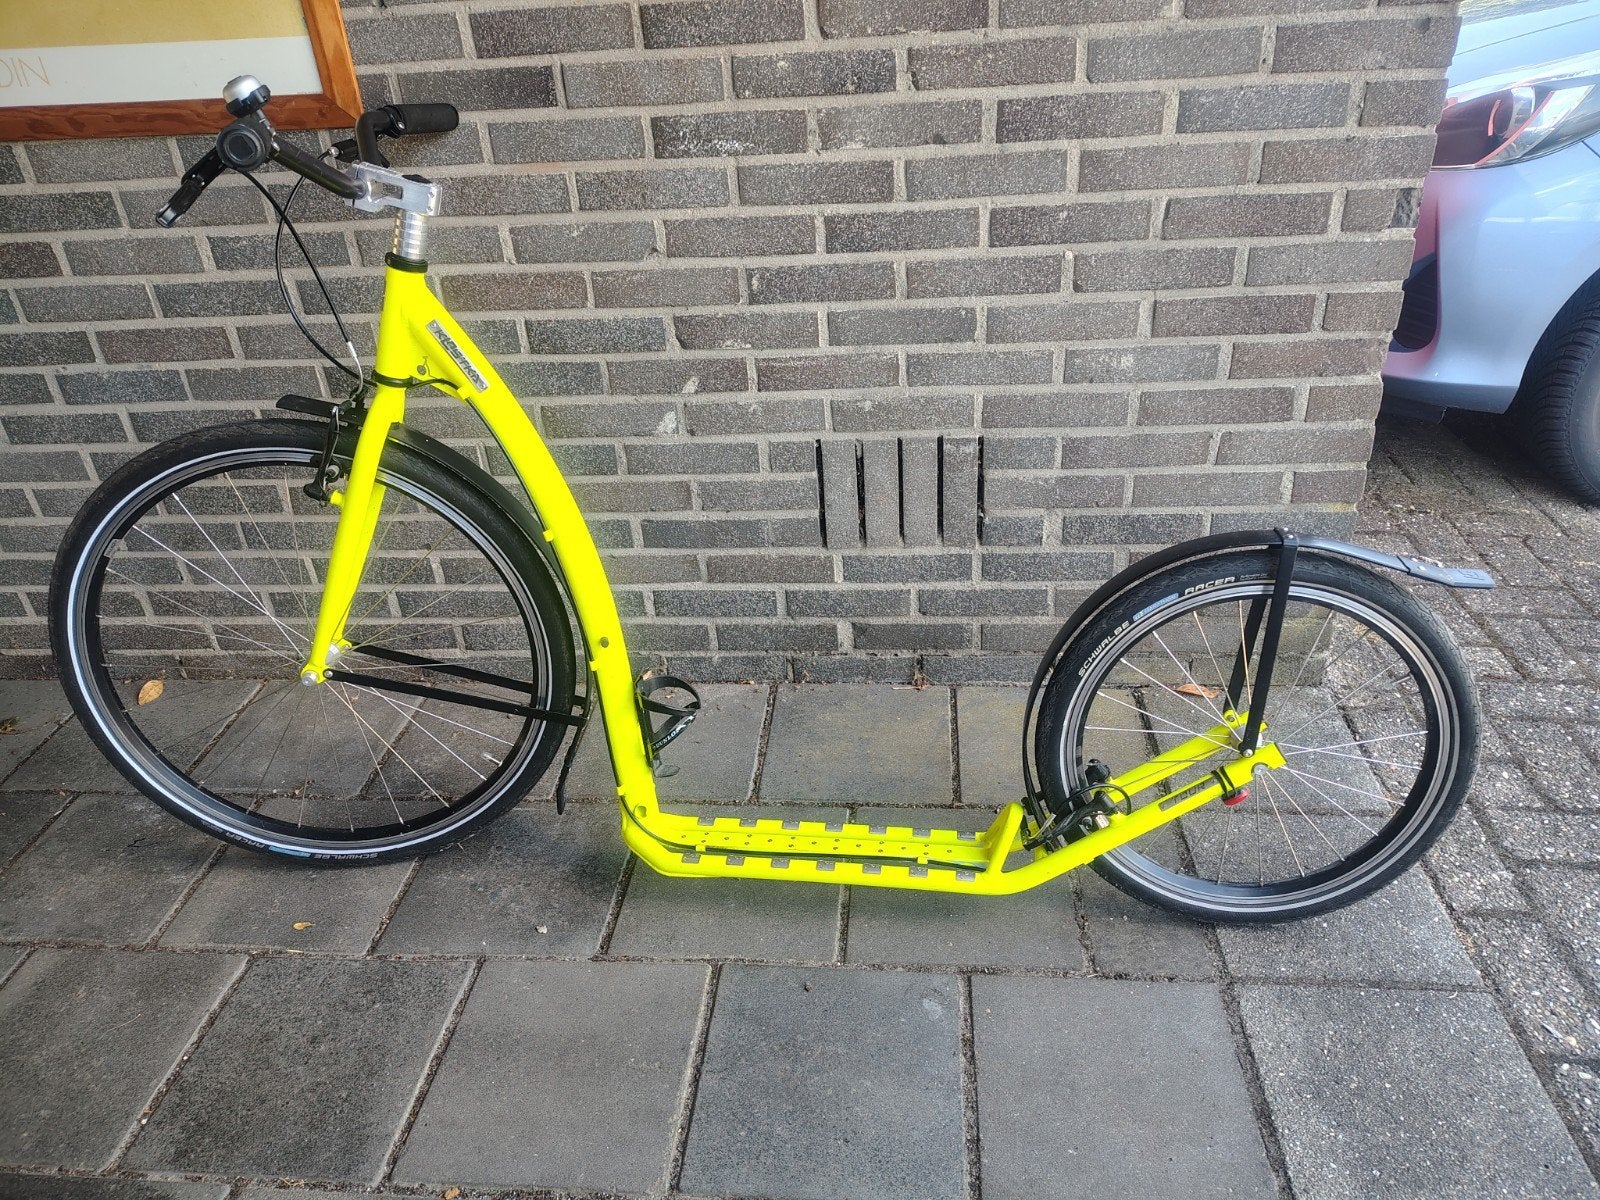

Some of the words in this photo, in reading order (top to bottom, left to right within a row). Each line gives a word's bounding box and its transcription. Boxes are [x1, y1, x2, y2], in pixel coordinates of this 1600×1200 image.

[1078, 620, 1130, 677] SCHWALBE
[1184, 576, 1236, 596] RACER
[225, 832, 266, 849] RACER
[314, 852, 379, 860] SCHWALBE
